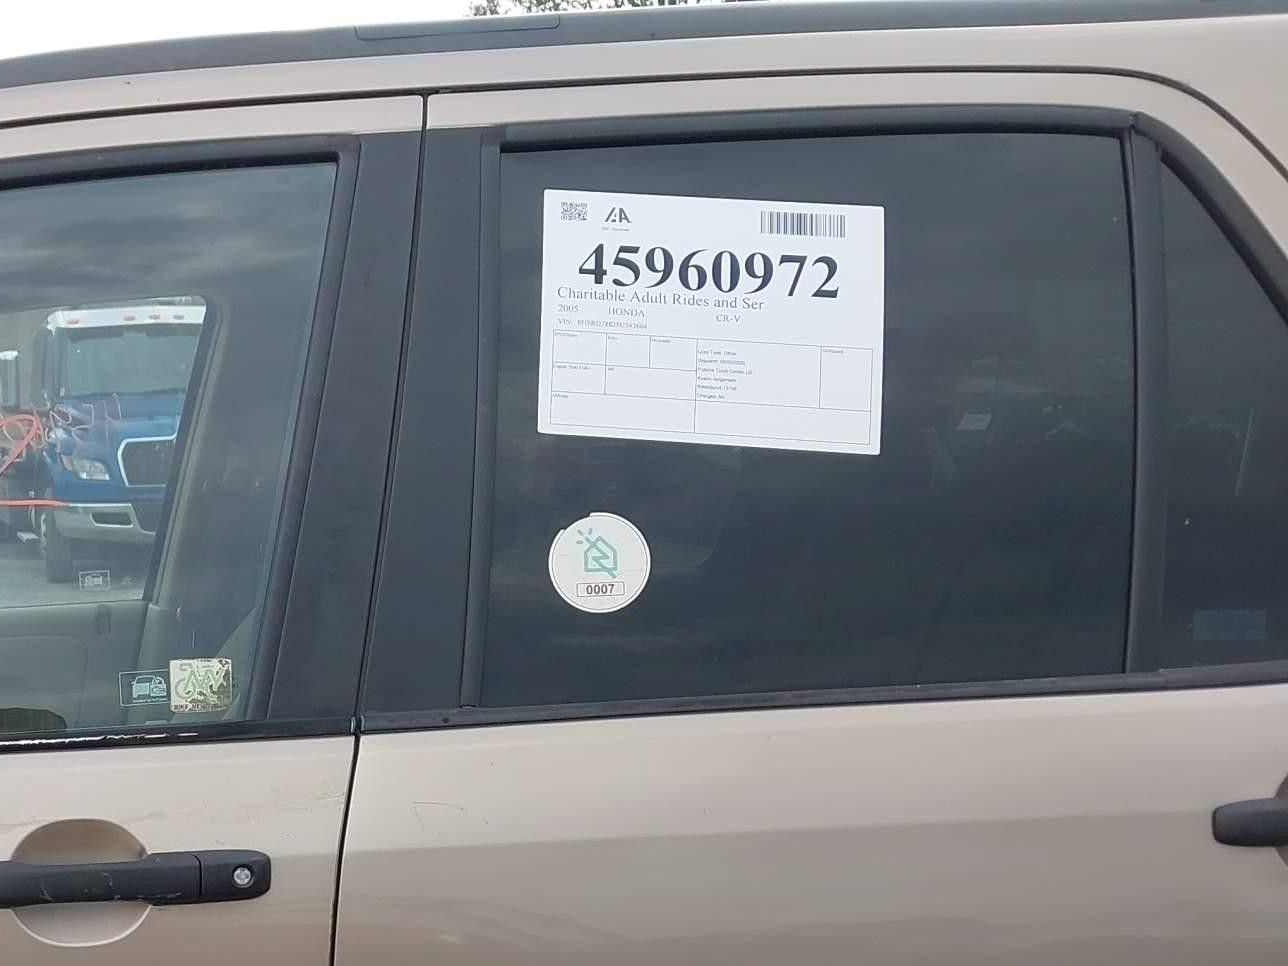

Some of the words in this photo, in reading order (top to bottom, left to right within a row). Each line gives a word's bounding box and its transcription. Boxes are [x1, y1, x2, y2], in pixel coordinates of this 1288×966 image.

[578, 243, 840, 299] 45960972
[557, 286, 626, 302] Charitable
[630, 290, 667, 305] Adult
[672, 293, 710, 307] Rides
[713, 297, 737, 308] and
[742, 297, 764, 310] Ser
[558, 304, 579, 313] 2005
[608, 306, 645, 318] HONDA
[715, 313, 741, 322] CR-V
[586, 584, 615, 595] 0007
